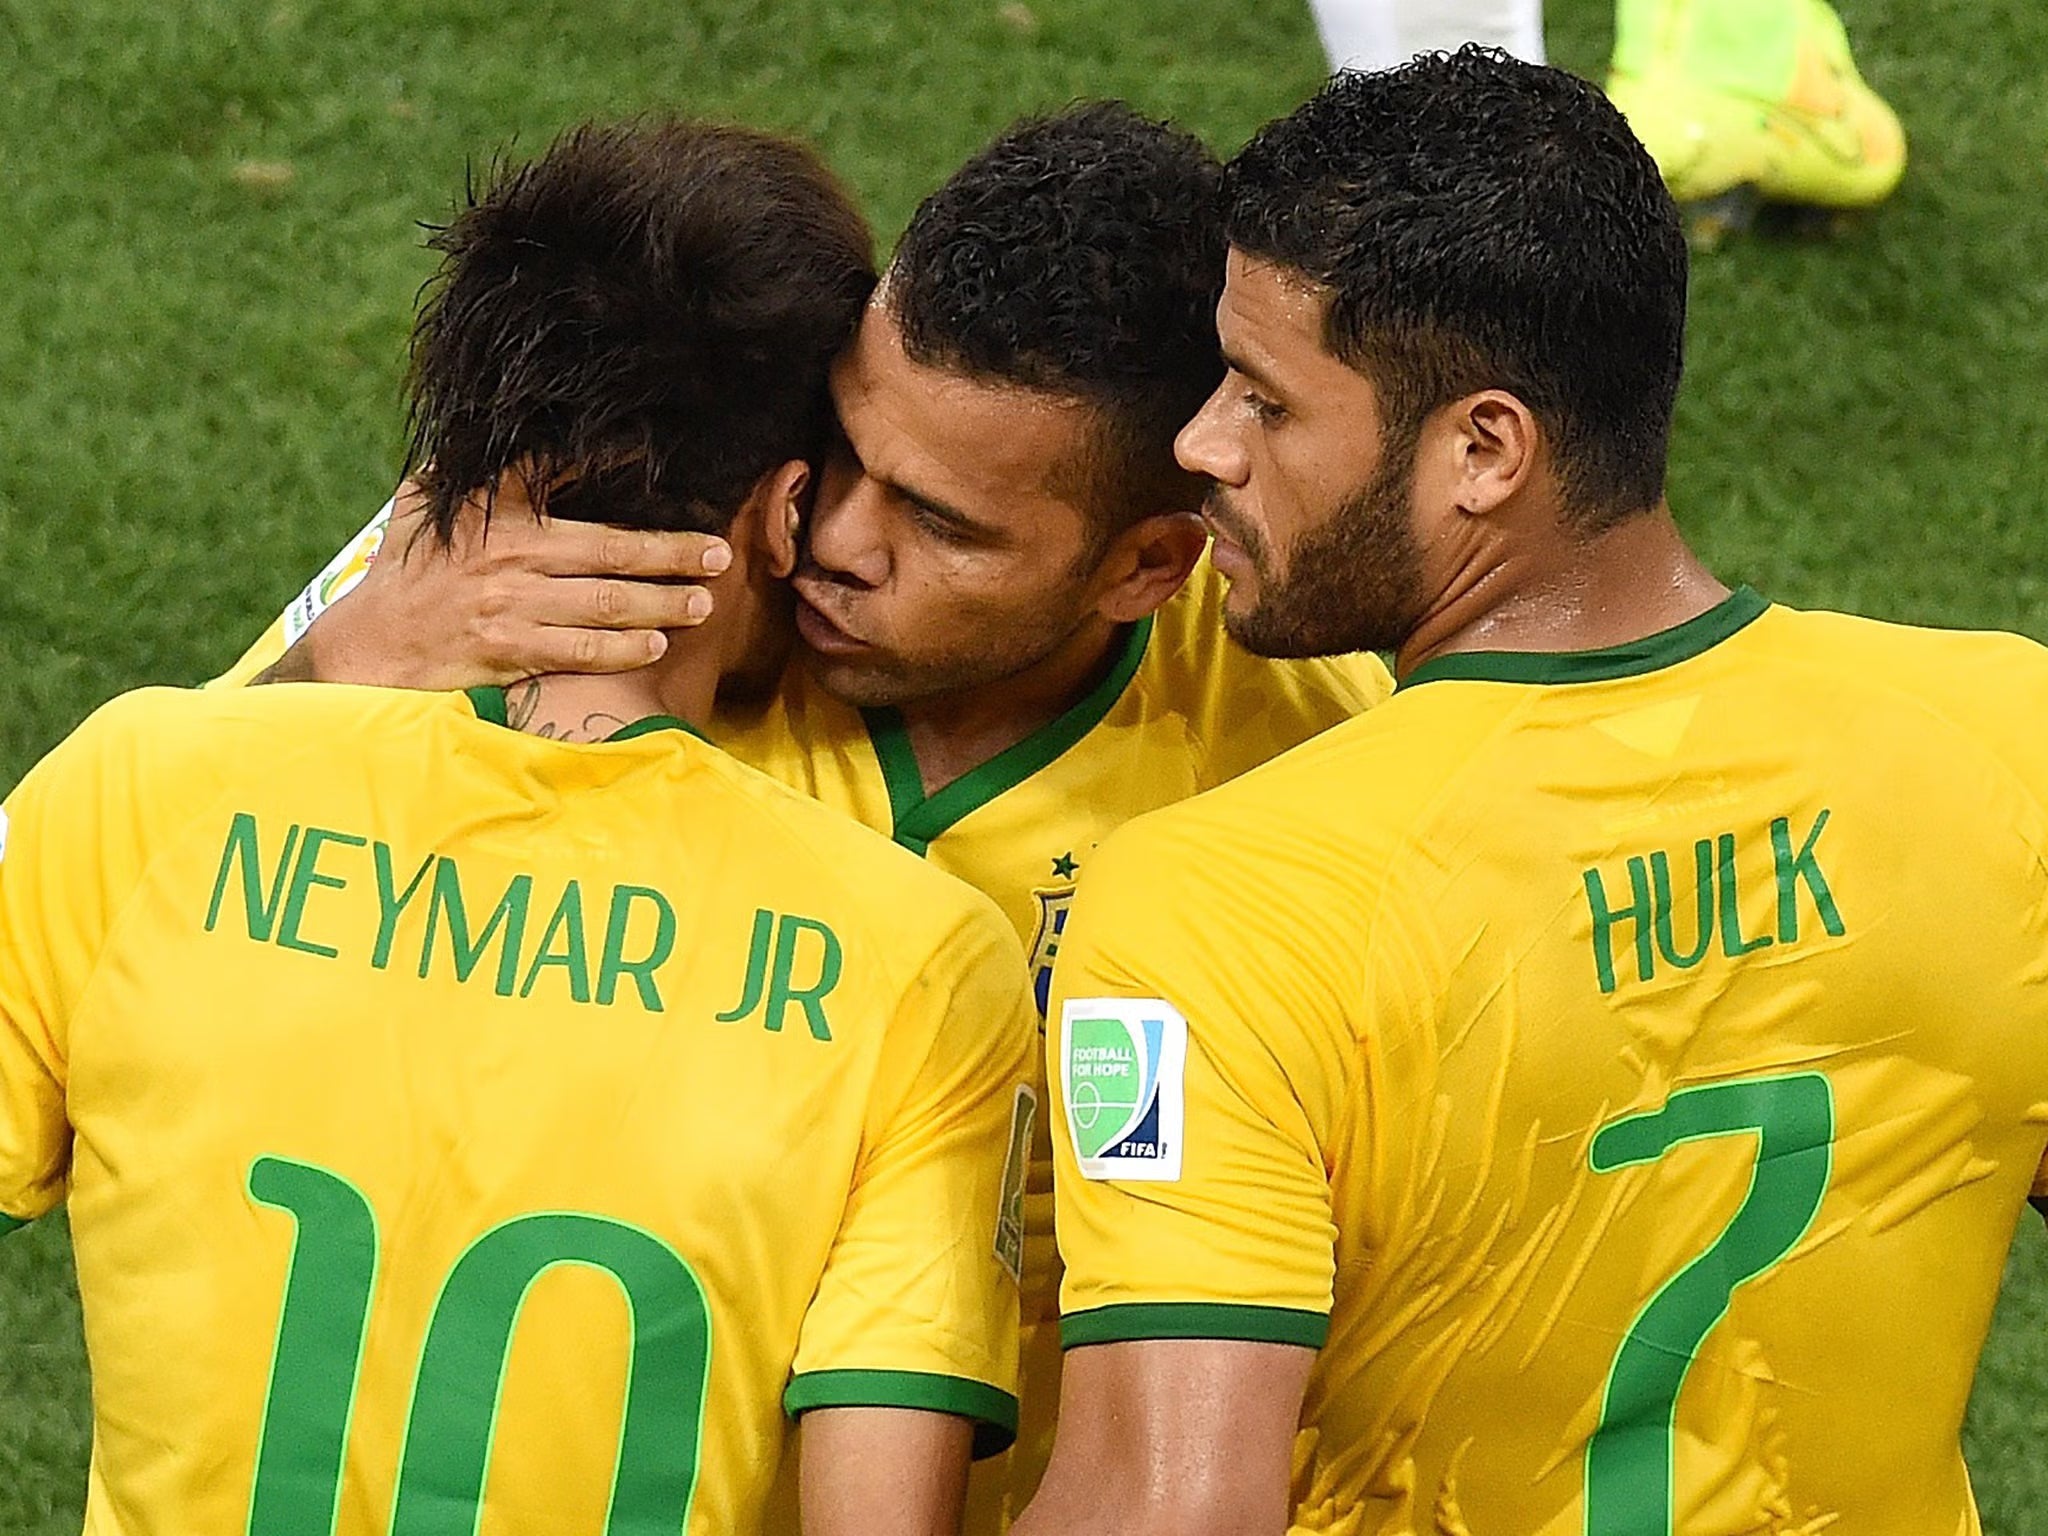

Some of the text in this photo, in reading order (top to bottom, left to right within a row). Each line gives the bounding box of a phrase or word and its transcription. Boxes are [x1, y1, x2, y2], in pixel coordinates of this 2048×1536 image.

[205, 812, 843, 1042] NEYMAR JR
[1583, 808, 1846, 993] HULK
[1073, 1047, 1133, 1062] FOOTBALL
[1073, 1063, 1129, 1077] FOR HOPE
[1120, 1142, 1156, 1157] FIFA
[247, 1153, 713, 1536] 10
[1583, 1070, 1835, 1536] 7
